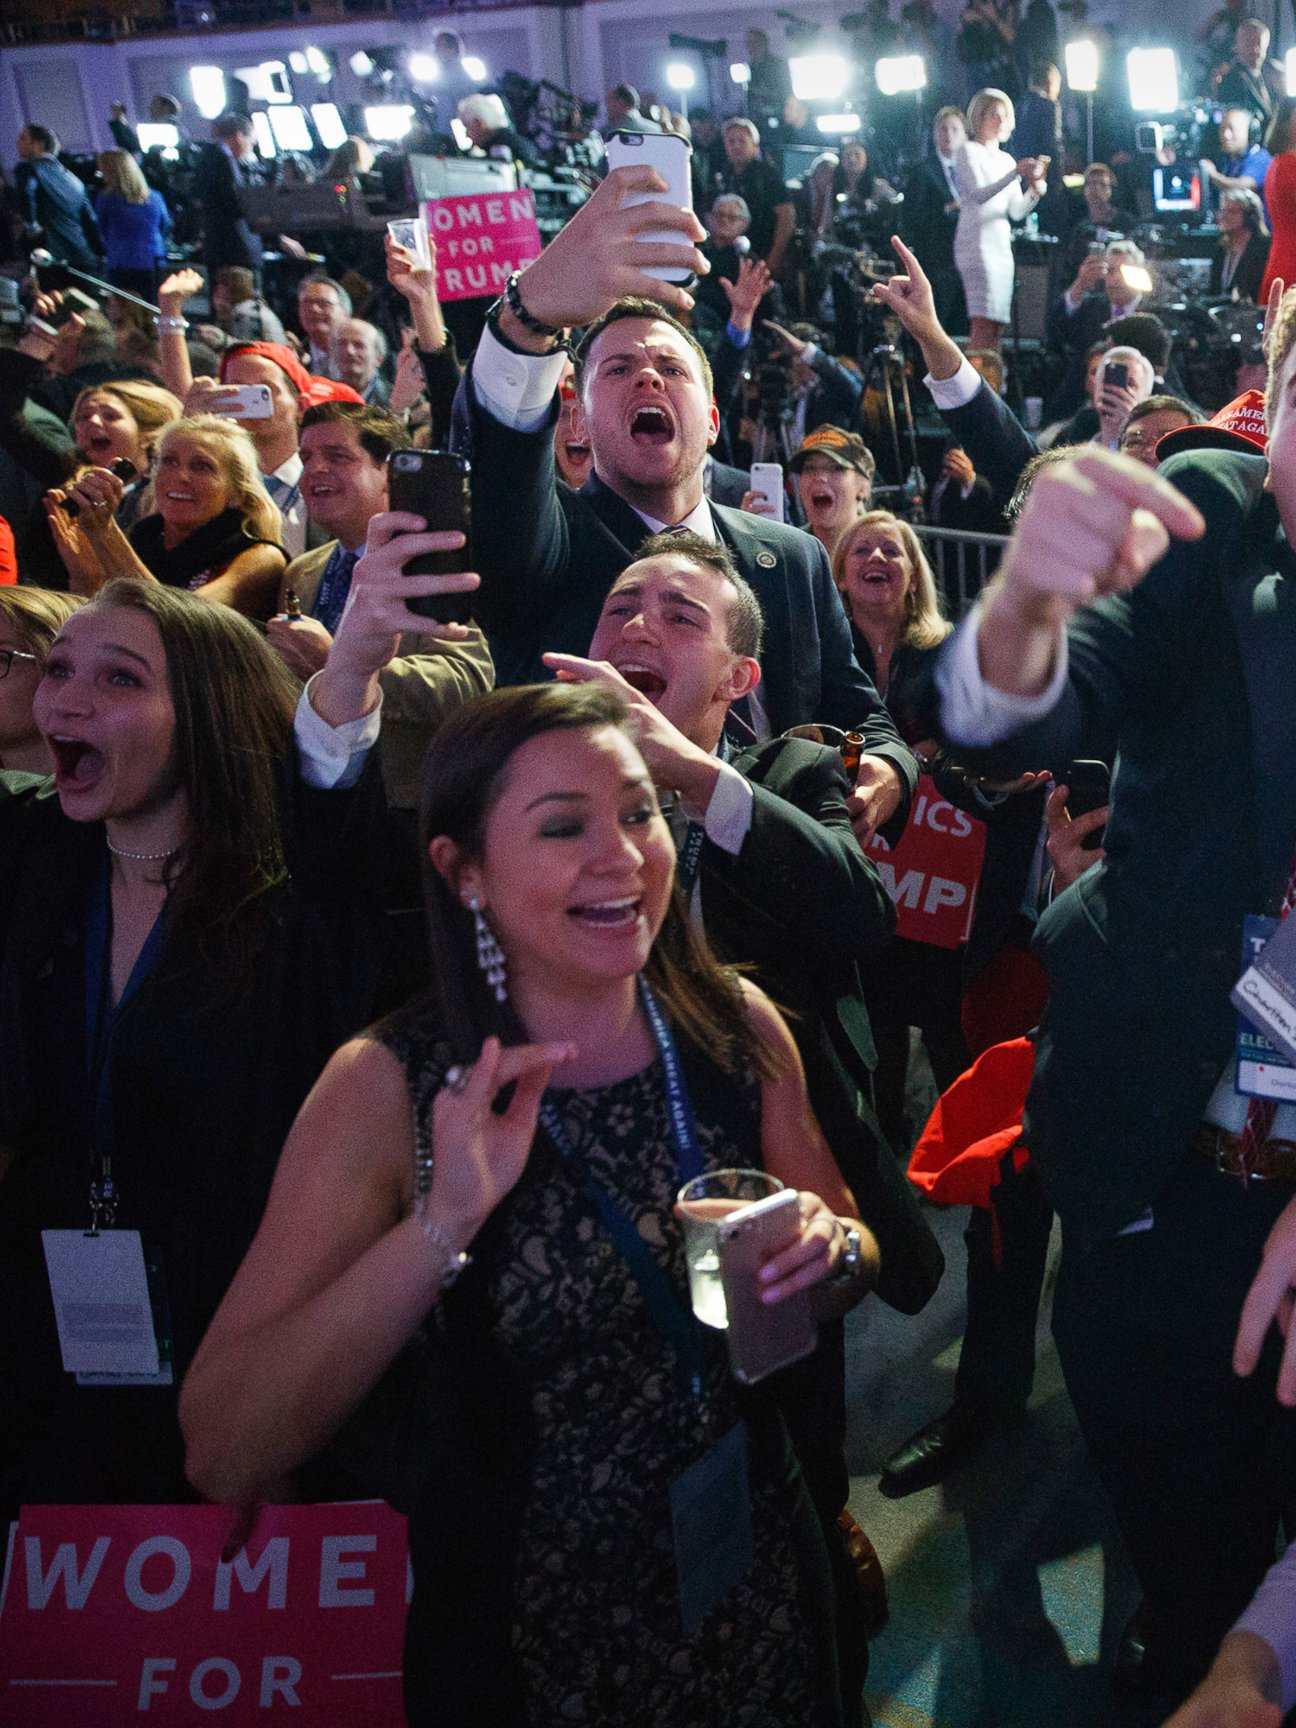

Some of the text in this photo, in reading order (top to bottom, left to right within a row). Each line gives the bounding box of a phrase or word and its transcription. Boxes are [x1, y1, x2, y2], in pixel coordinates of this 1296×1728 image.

[433, 196, 533, 231] OMEN
[448, 236, 494, 257] FOR
[443, 259, 533, 292] RUM
[1238, 422, 1265, 434] AGA
[913, 795, 973, 838] ICS
[876, 861, 967, 915] MP
[1239, 1033, 1274, 1050] ELEC
[23, 1534, 414, 1612] WOME
[137, 1656, 304, 1711] FOR
